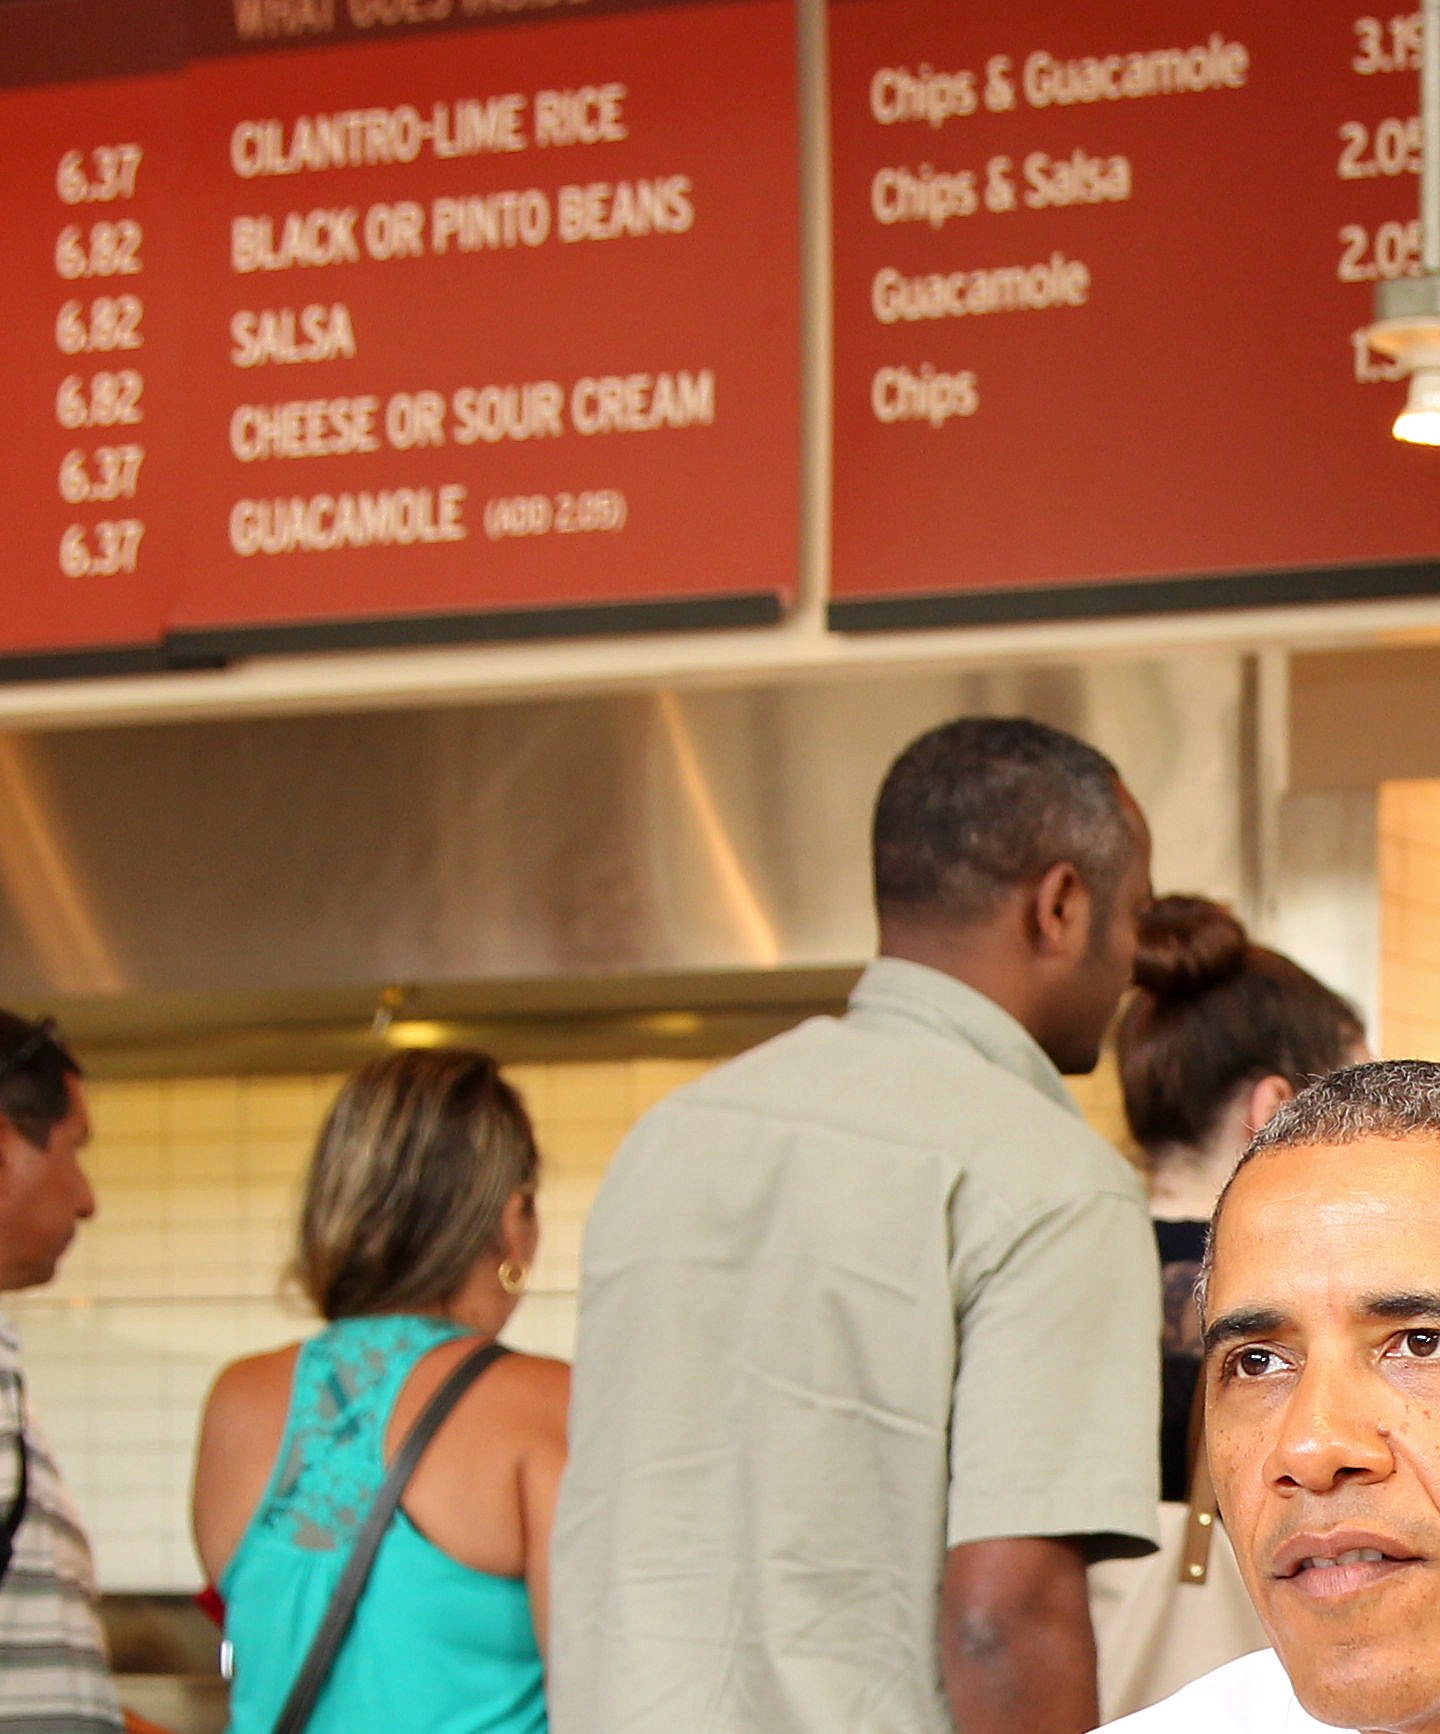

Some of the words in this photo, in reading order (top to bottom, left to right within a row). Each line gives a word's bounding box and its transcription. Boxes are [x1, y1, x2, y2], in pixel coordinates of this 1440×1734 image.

[234, 0, 335, 41] WHAT
[870, 63, 976, 128] Chips
[984, 55, 1016, 112] &
[1024, 33, 1250, 108] Guacamole
[230, 93, 527, 179] CILANTRO-LIME
[535, 83, 628, 148] RICE
[58, 144, 144, 204] 6.37
[870, 163, 976, 229] Chips
[984, 156, 1016, 212] &
[1023, 148, 1133, 209] Salsa
[56, 219, 143, 279] 6.82
[231, 206, 358, 274] BLACK
[364, 201, 424, 262] OR
[431, 189, 551, 254] PINTO
[558, 174, 695, 244] BEANS
[871, 250, 1091, 324] Guacamole
[56, 294, 144, 356] 6.82
[229, 303, 356, 368] SALSA
[57, 370, 144, 429] 6.82
[229, 395, 379, 462] CHEESE
[385, 389, 445, 449] OR
[453, 380, 563, 446] SOUR
[571, 368, 716, 436] CREAM
[870, 363, 978, 428] Chips
[59, 444, 144, 504] 6.37
[59, 519, 144, 578] 6.37
[228, 484, 468, 557] GUACAMOLE
